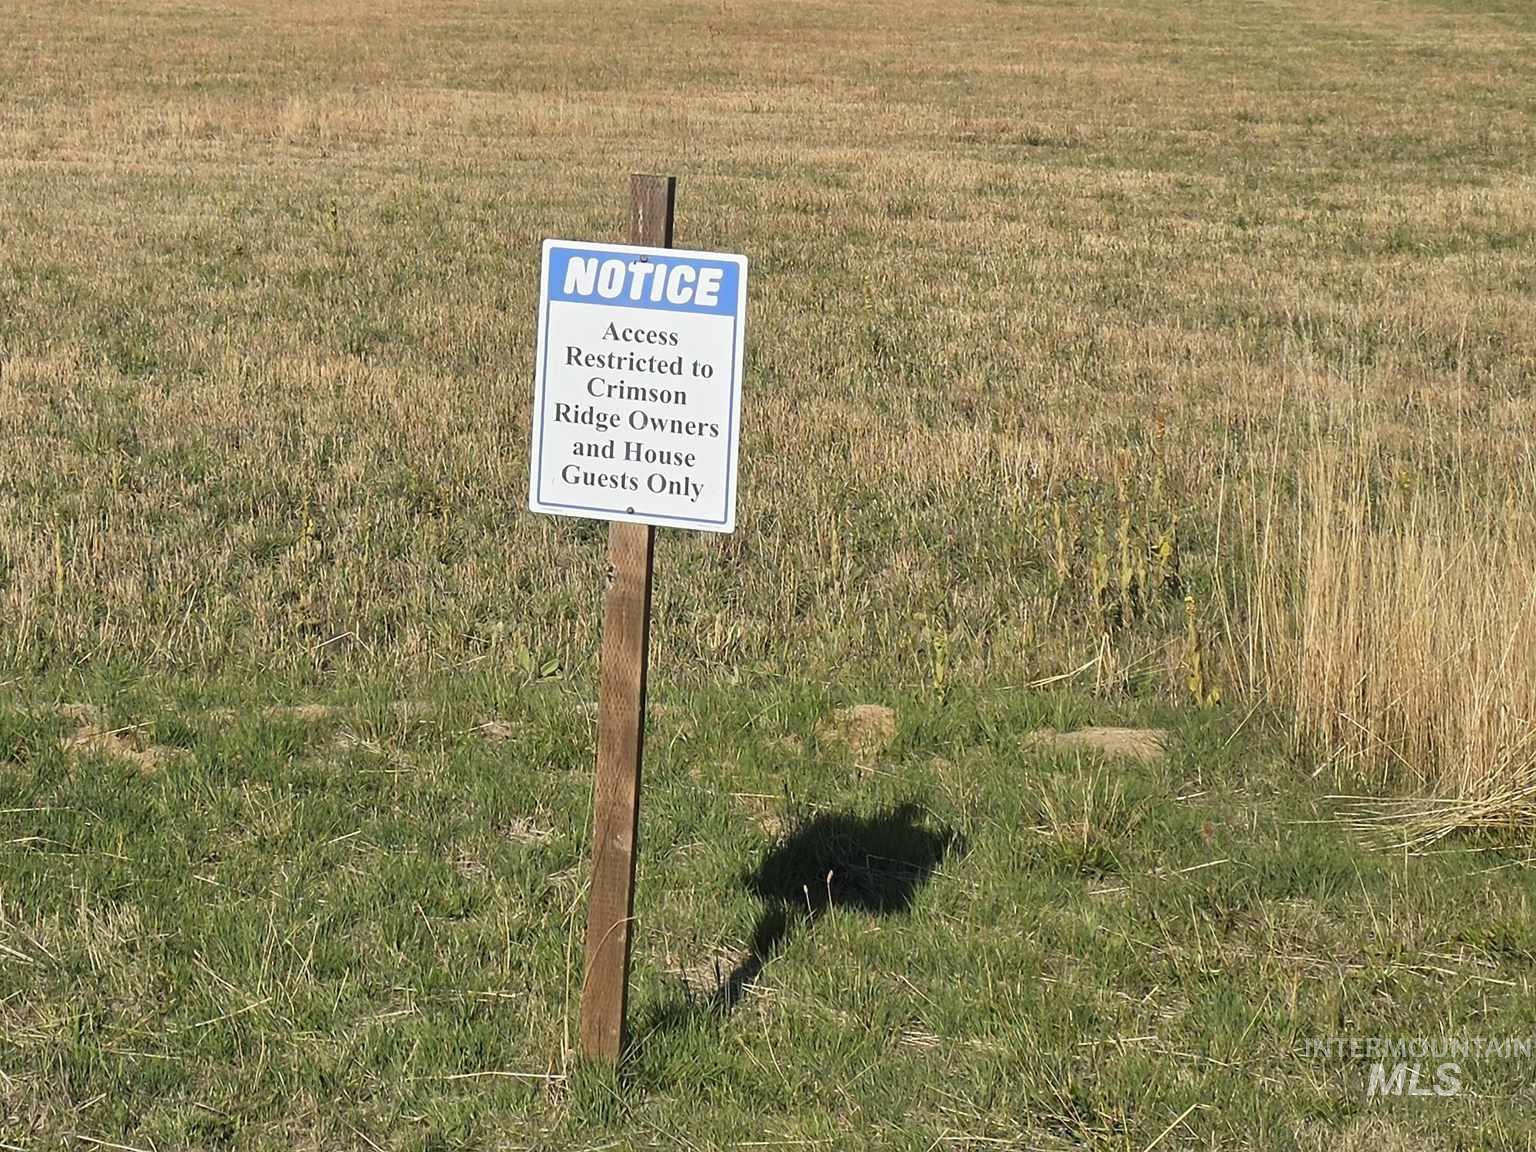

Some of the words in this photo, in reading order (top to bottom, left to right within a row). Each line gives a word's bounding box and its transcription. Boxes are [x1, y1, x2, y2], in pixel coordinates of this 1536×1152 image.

[564, 256, 723, 306] NOTICE
[602, 322, 679, 346] Access
[566, 346, 682, 375] Restricted
[692, 360, 713, 378] to
[587, 377, 687, 405] Crimson
[554, 403, 621, 432] Ridge
[629, 410, 719, 437] Owners
[573, 440, 614, 459] and
[624, 442, 696, 467] House
[561, 465, 638, 491] Guests
[647, 473, 704, 502] Only
